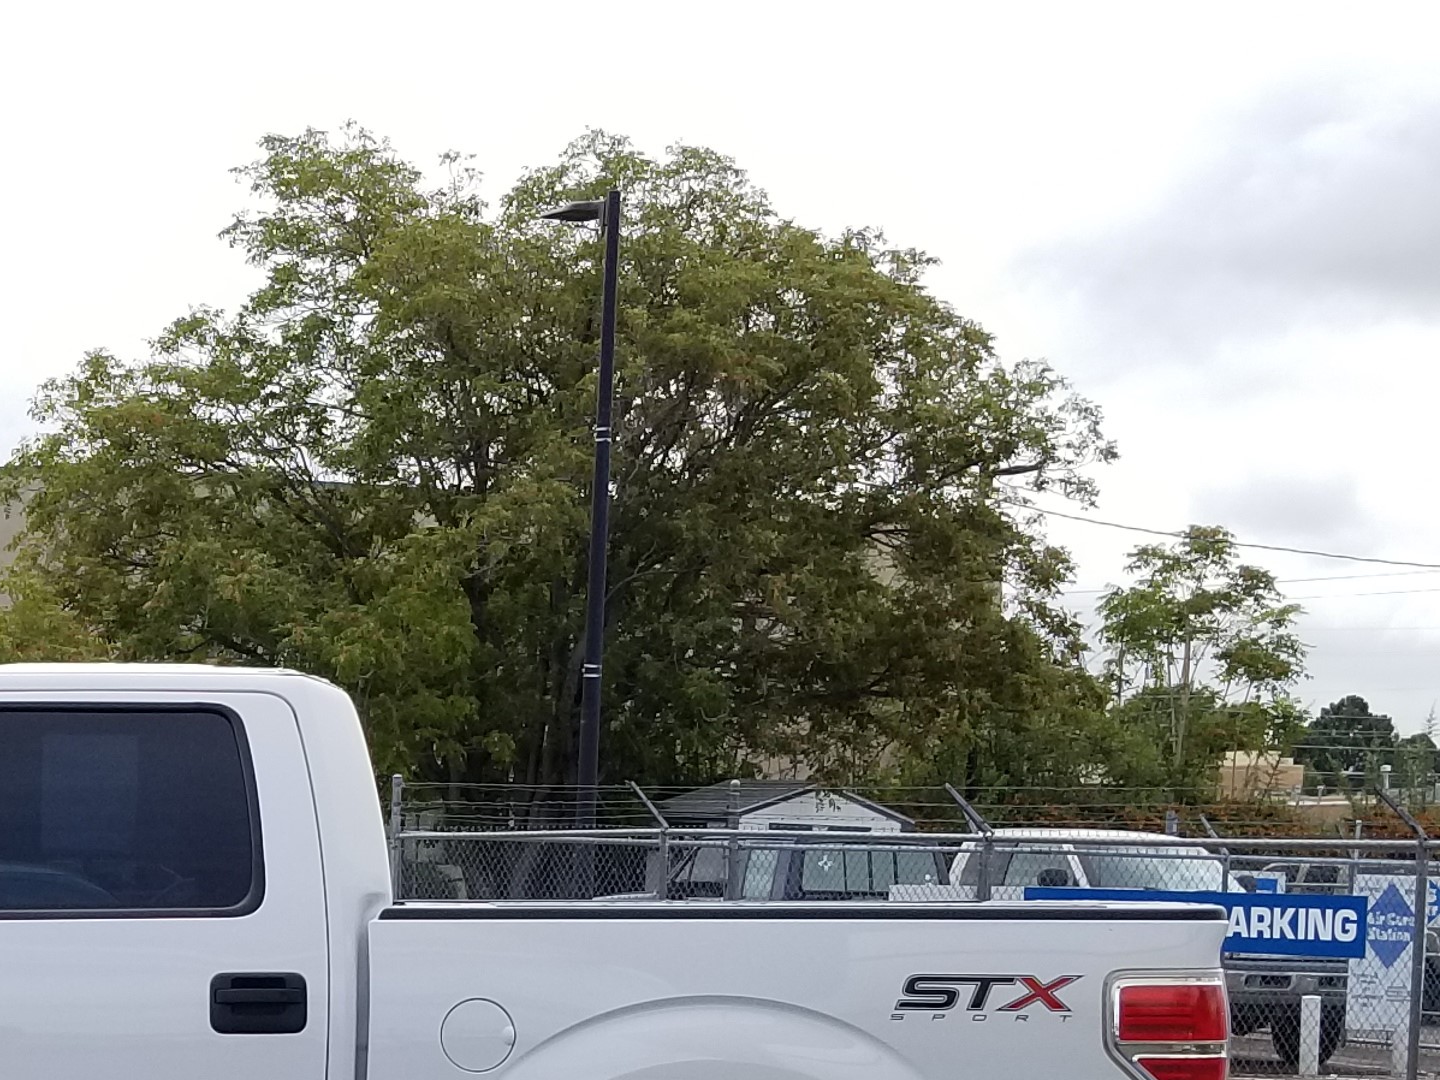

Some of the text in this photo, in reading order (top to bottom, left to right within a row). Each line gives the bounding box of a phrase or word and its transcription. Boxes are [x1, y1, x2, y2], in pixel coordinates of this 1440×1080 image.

[1226, 906, 1358, 942] ARKING
[894, 973, 1085, 1012] STX
[889, 1013, 1073, 1023] SPORT
